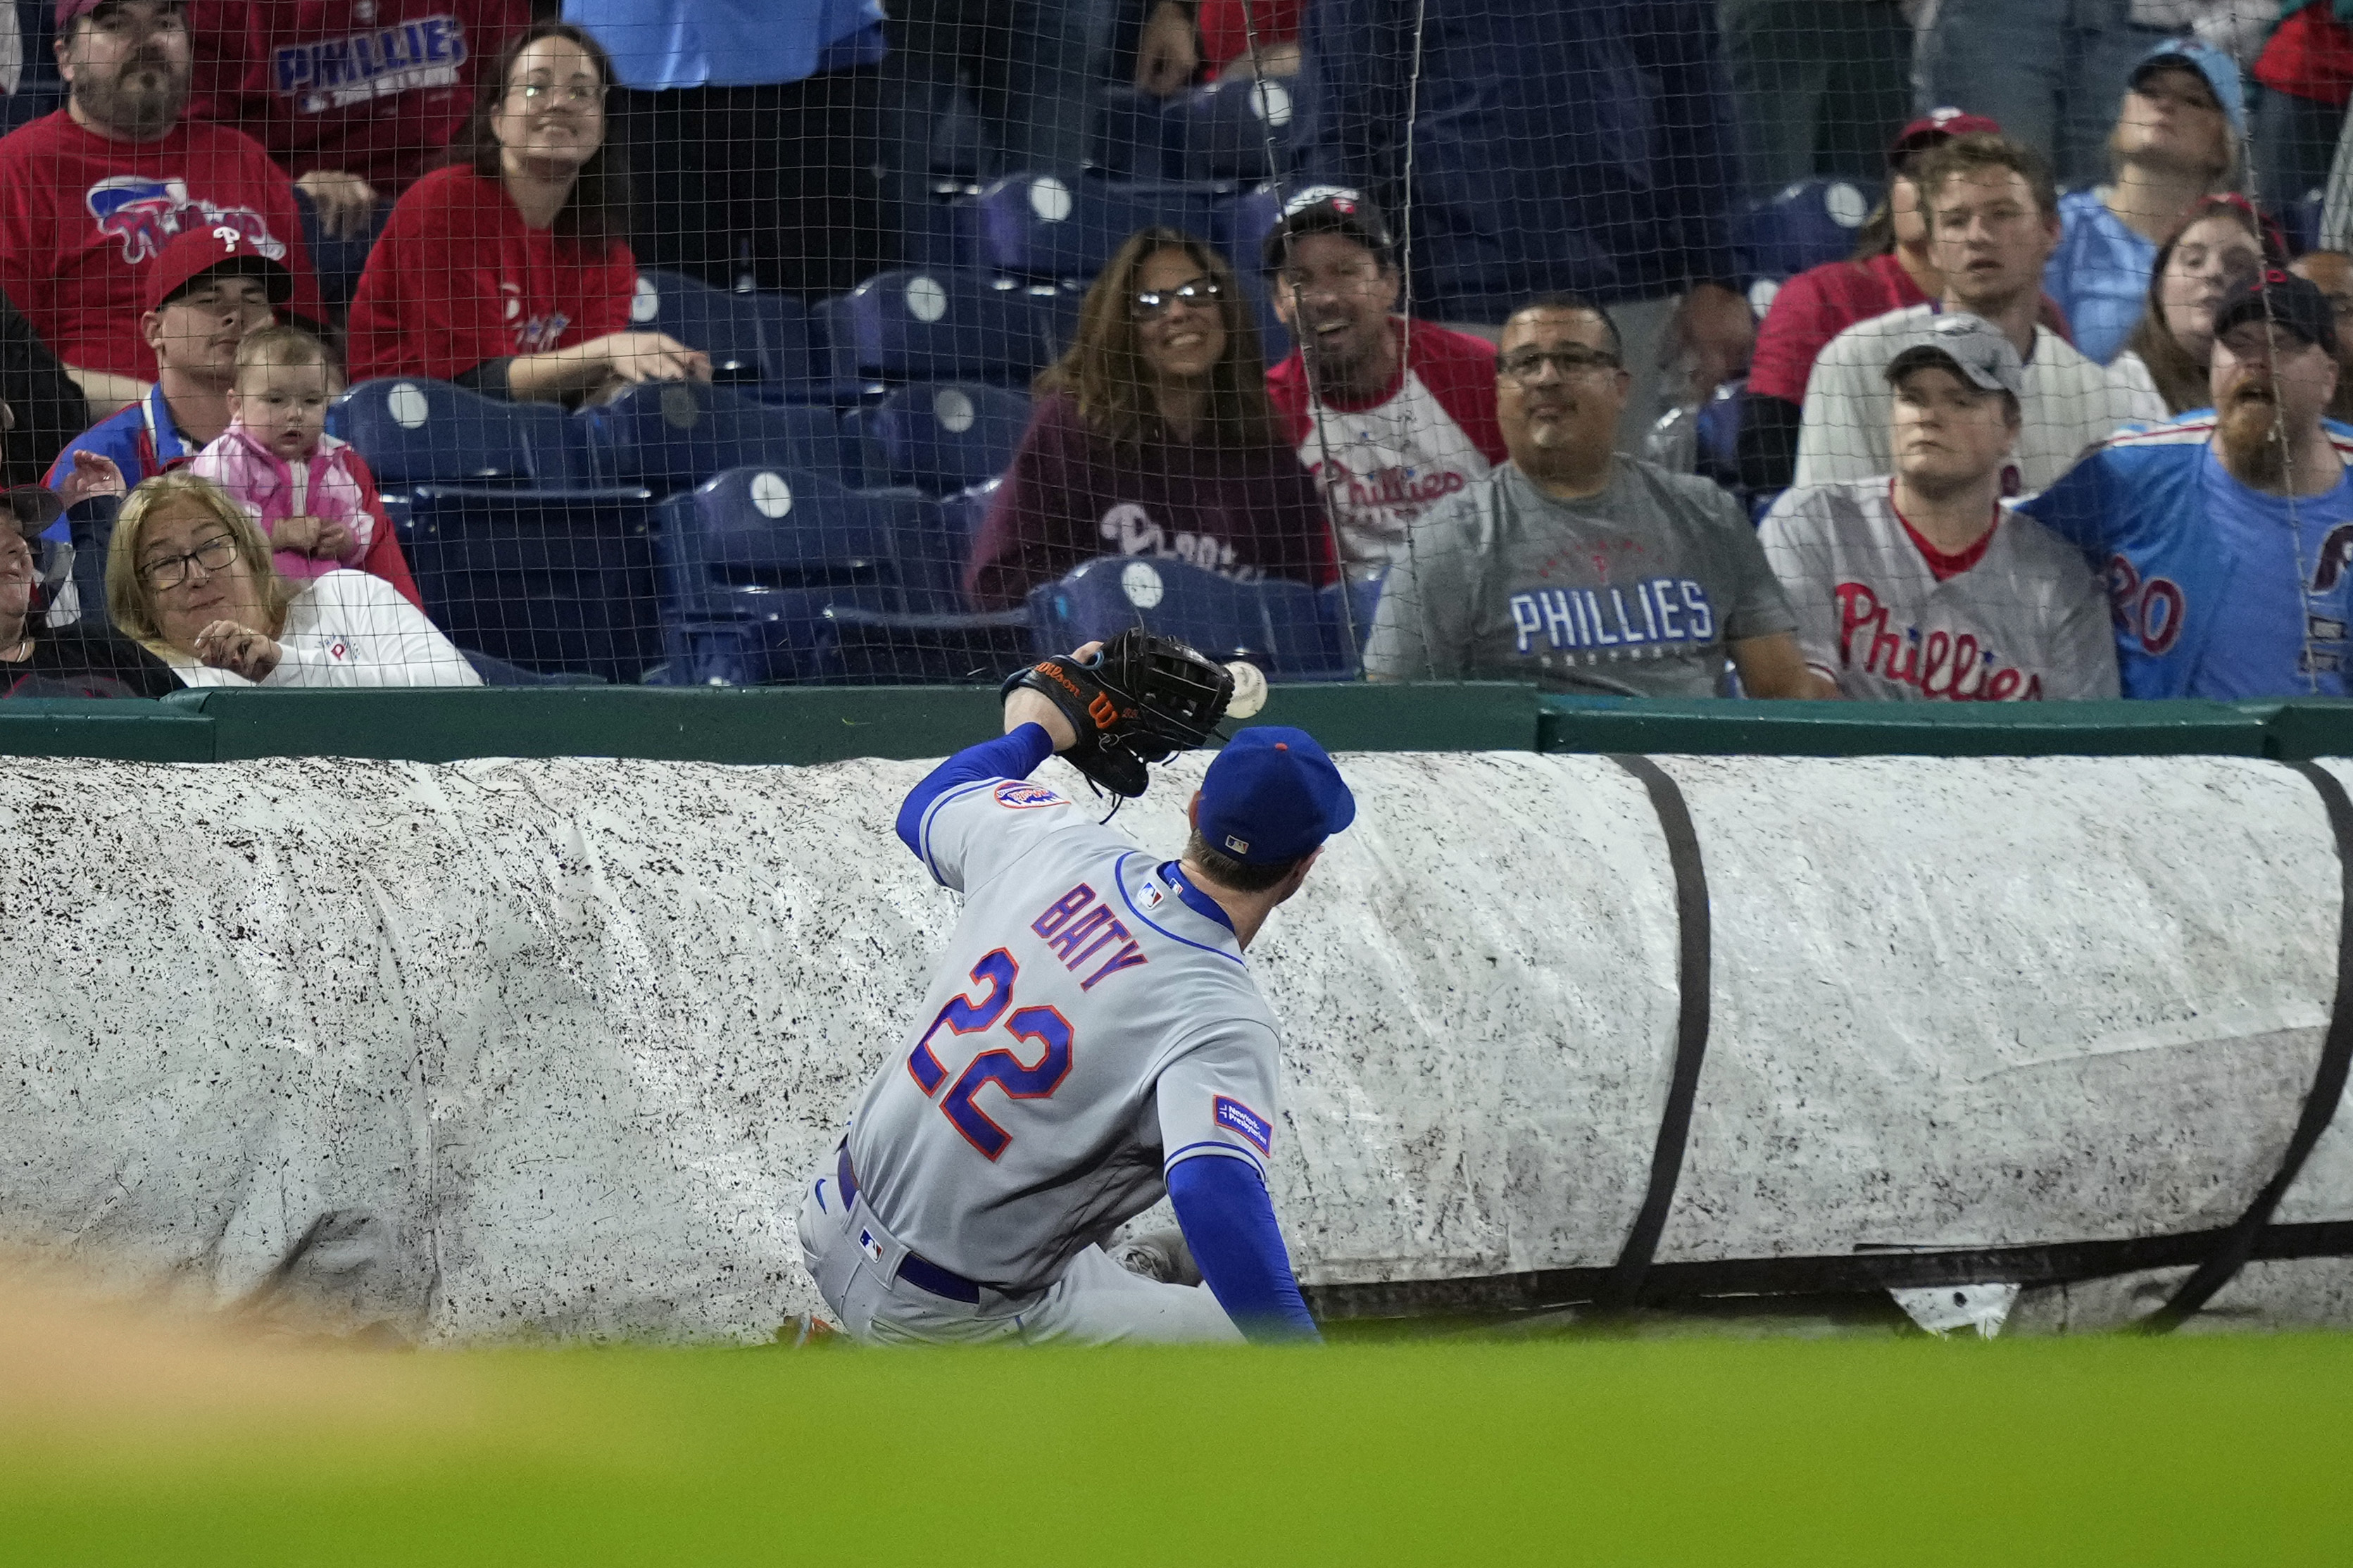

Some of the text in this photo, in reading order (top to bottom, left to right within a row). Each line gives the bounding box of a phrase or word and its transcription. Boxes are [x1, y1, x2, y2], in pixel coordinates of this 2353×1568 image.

[213, 226, 240, 253] P
[1510, 577, 1715, 653] PHILLIES
[1035, 661, 1081, 698] Wilson
[1030, 882, 1149, 993] BATY
[907, 946, 1074, 1163] 22
[1229, 1112, 1267, 1146] Presbyterian
